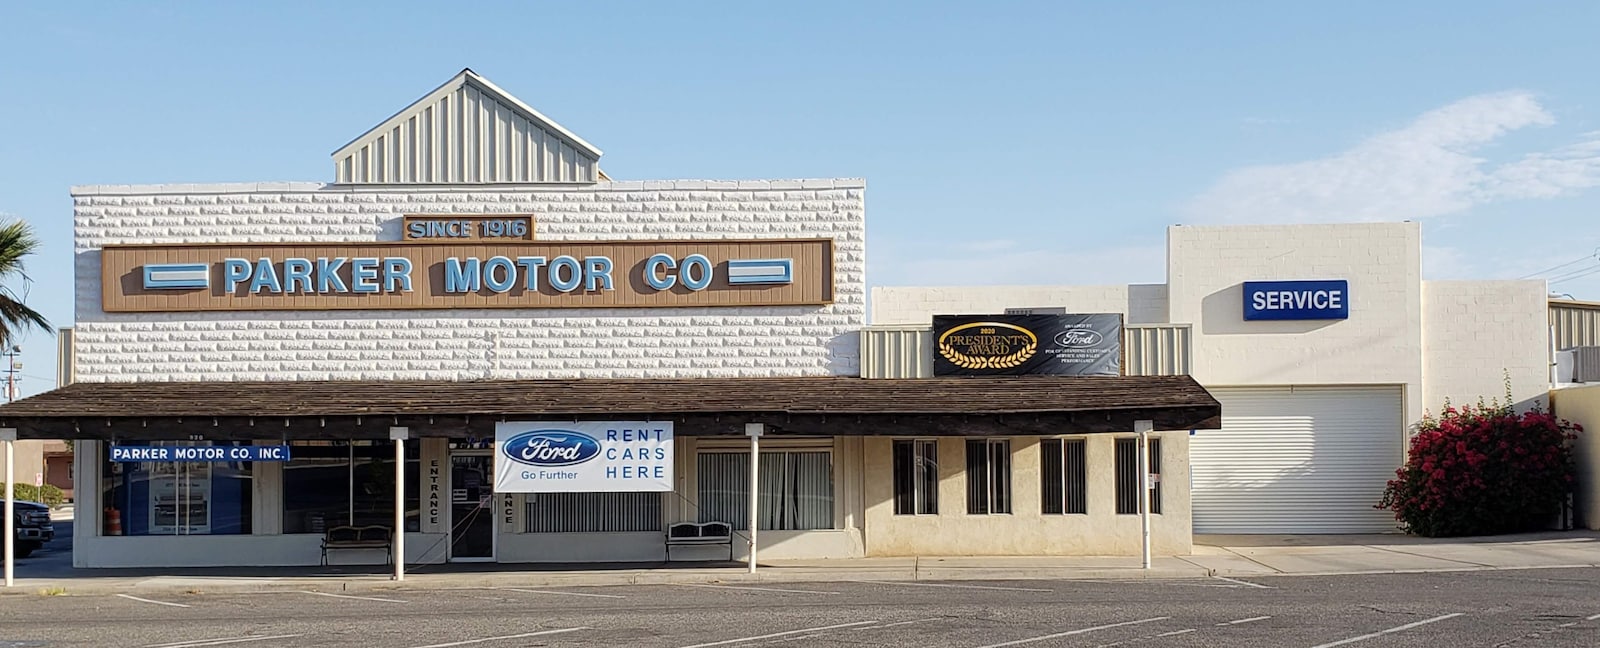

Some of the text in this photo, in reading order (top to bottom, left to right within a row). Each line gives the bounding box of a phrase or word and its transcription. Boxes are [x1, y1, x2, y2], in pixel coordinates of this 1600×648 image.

[409, 219, 528, 239] SINCE 1916
[224, 253, 714, 294] PARKER MOTOR CO
[1252, 290, 1342, 310] SERVICE
[949, 335, 1029, 346] PRESIDENT'S
[1062, 331, 1095, 345] Ford
[966, 344, 1010, 355] AWARD
[606, 429, 664, 442] RENT
[113, 448, 285, 460] PARKER MOTOR CO. INC.
[521, 434, 583, 461] Ford
[606, 447, 665, 460] CARS
[521, 470, 578, 480] Go Further
[606, 466, 665, 479] HERE
[430, 459, 439, 524] ENTRANCE
[504, 492, 513, 524] ANCE
